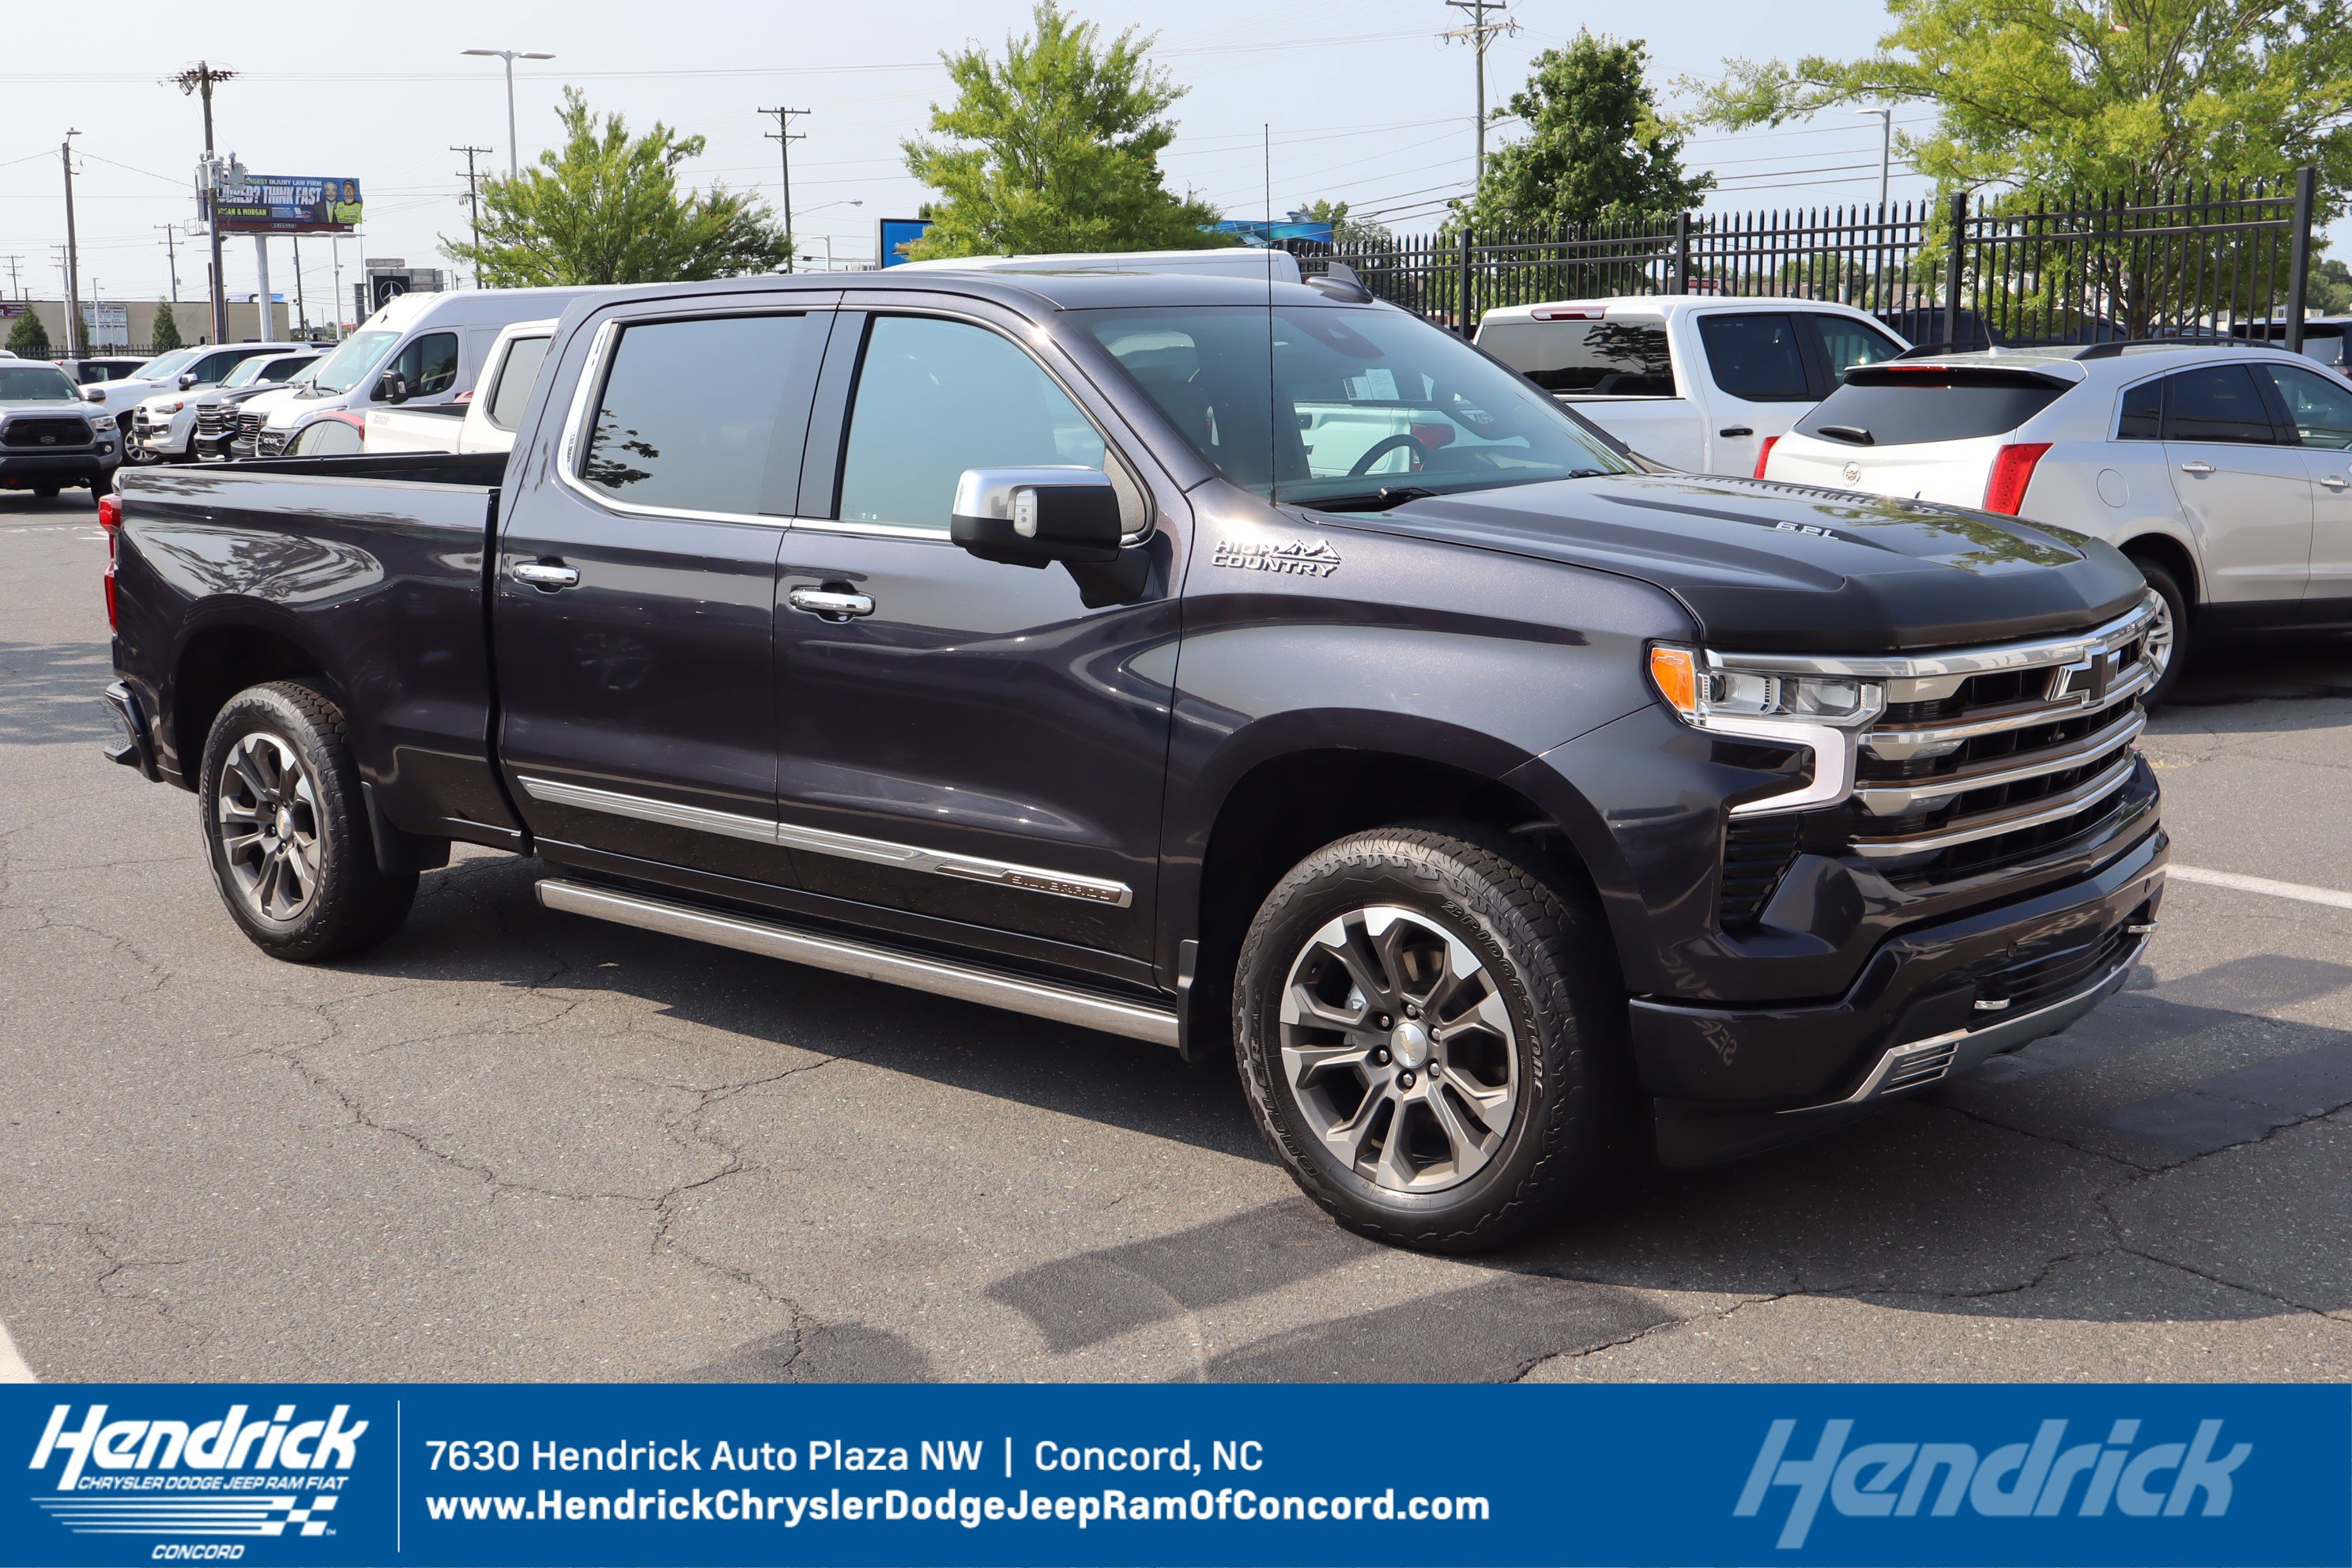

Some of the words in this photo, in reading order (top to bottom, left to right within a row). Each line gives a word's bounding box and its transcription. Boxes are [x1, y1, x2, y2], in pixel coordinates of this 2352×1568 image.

[262, 186, 294, 205] THINK
[295, 187, 322, 205] FAST
[1775, 521, 1839, 541] 6.2L
[1211, 554, 1338, 578] COUNTRY
